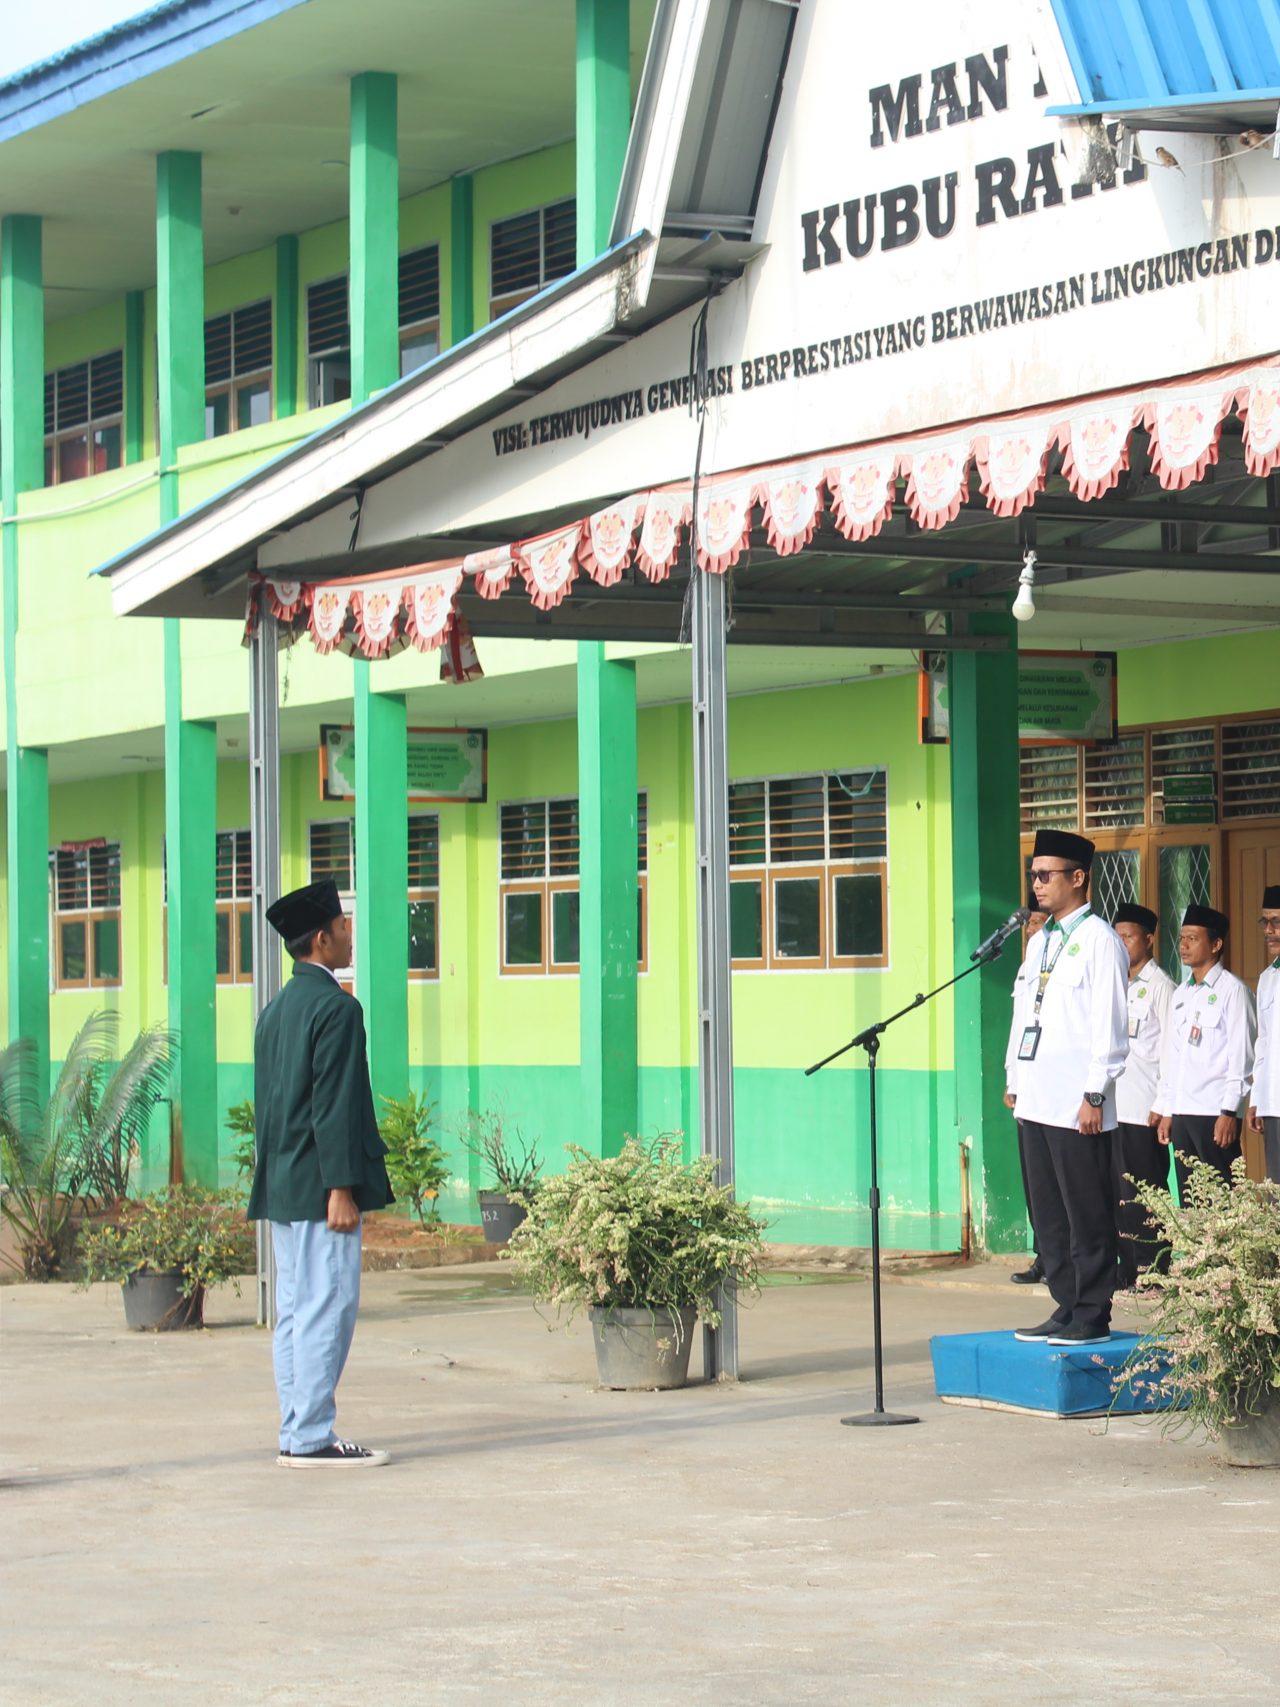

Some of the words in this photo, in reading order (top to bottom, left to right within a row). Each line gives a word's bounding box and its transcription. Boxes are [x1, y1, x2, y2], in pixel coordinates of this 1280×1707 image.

[869, 44, 1009, 148] MAN
[801, 171, 960, 272] KUBU
[493, 425, 527, 456] VISI:
[529, 389, 644, 446] TERWUJUDNYA
[931, 274, 1085, 343] BERWAWASAN
[1091, 233, 1249, 304] LINGKUNGAN
